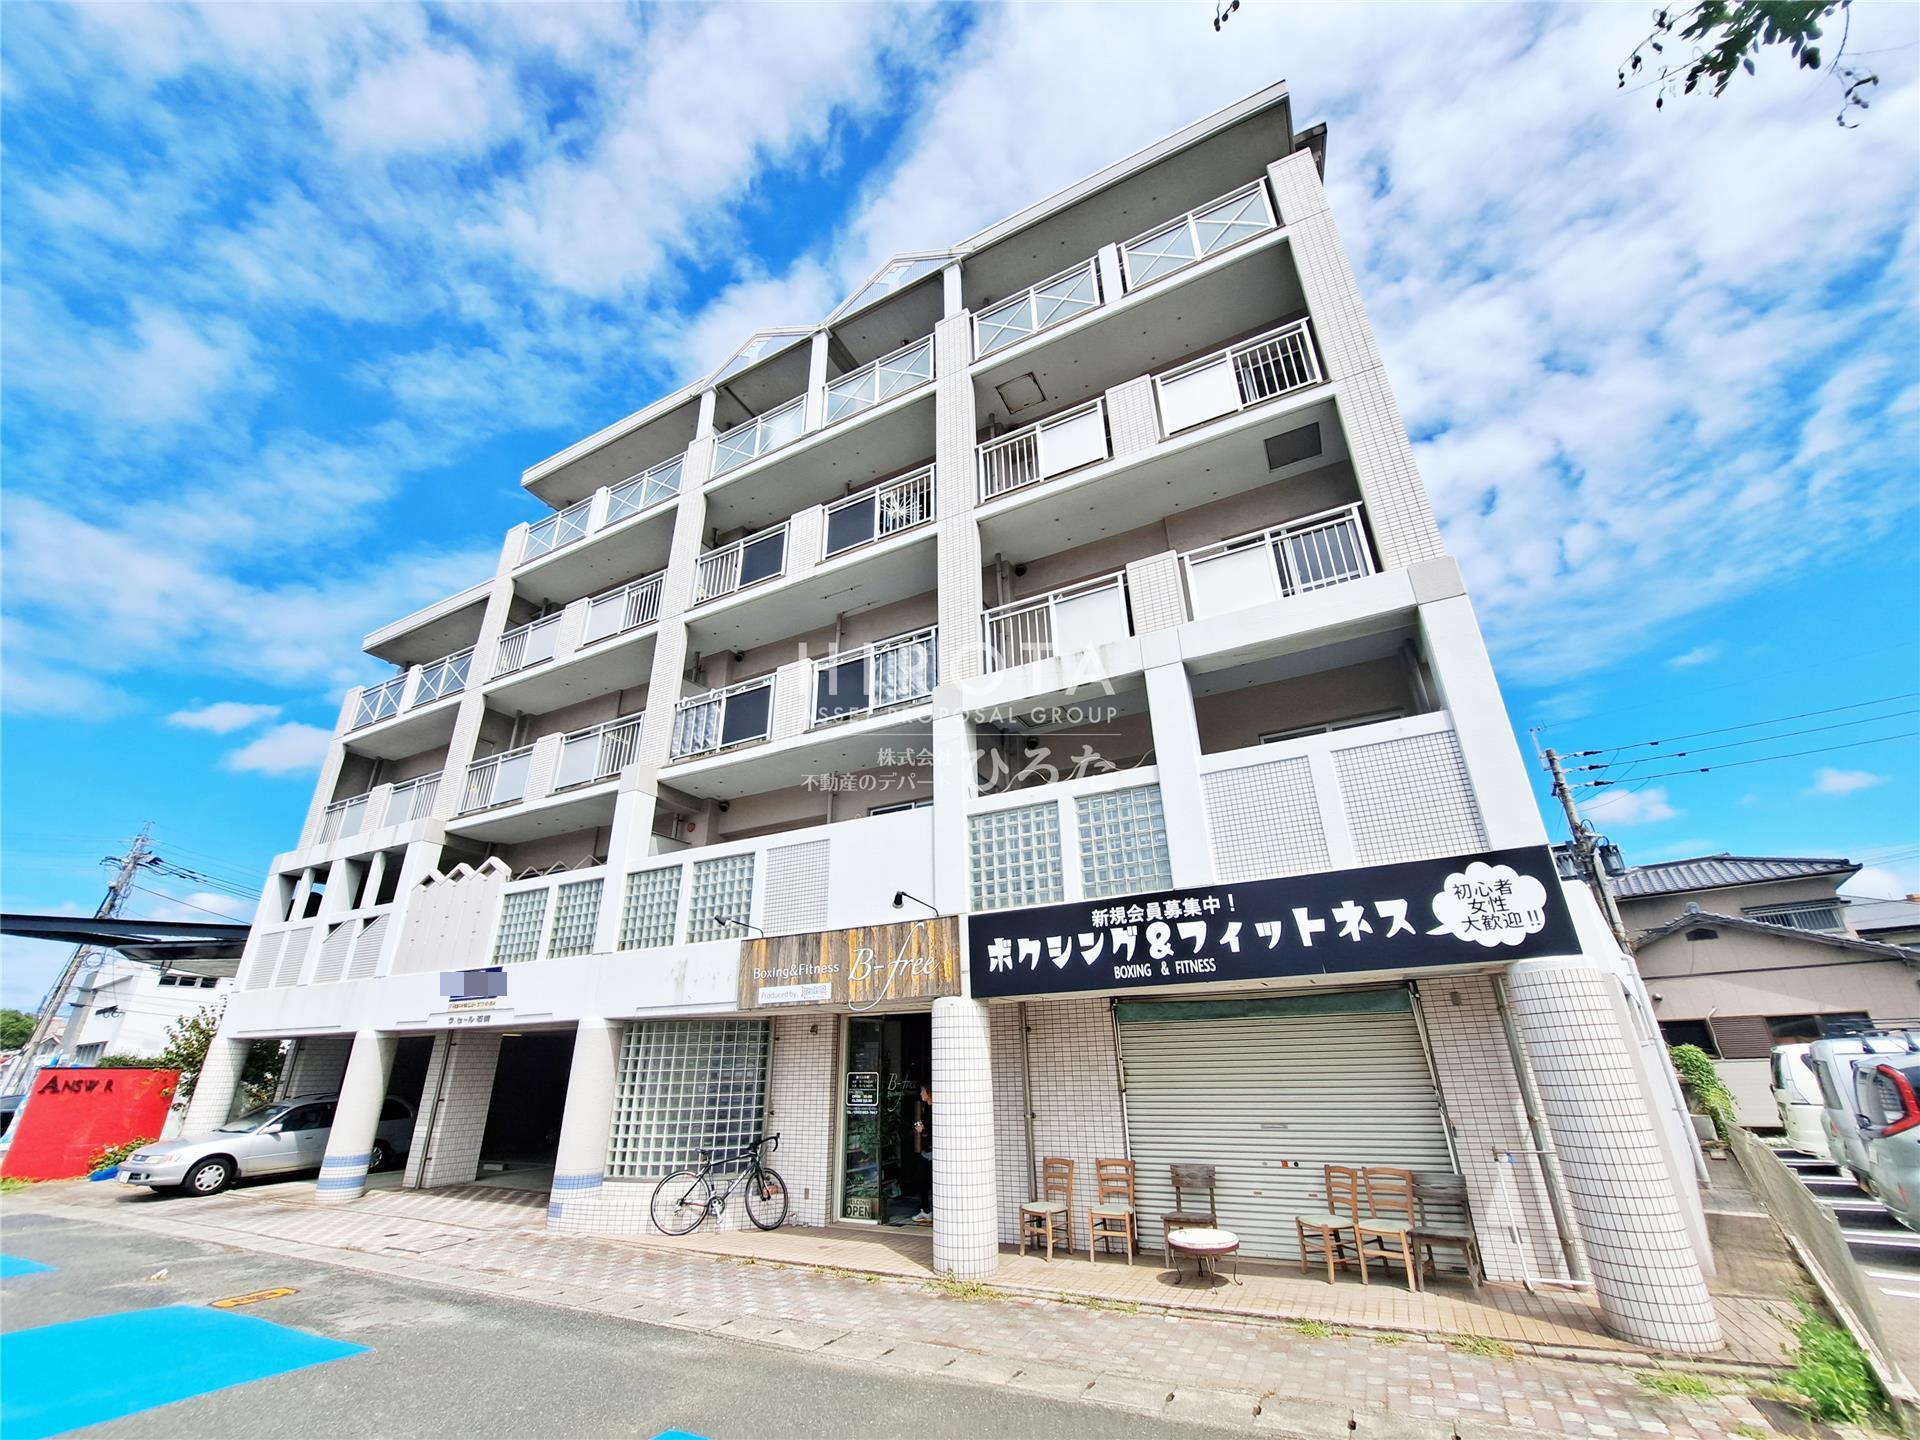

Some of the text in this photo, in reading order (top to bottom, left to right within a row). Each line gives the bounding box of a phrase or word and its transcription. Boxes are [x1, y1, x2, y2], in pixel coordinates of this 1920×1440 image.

[1453, 878, 1512, 900] 初心者
[1091, 894, 1236, 928] 新規会員募集中！
[1471, 896, 1510, 914] 女性
[753, 963, 840, 980] Boxing&Fitness
[848, 922, 940, 1011] B-free
[1113, 958, 1217, 979] BOXING & FITNESS
[761, 990, 788, 999] Produced
[789, 990, 797, 999] by
[846, 1205, 871, 1217] OPEN
